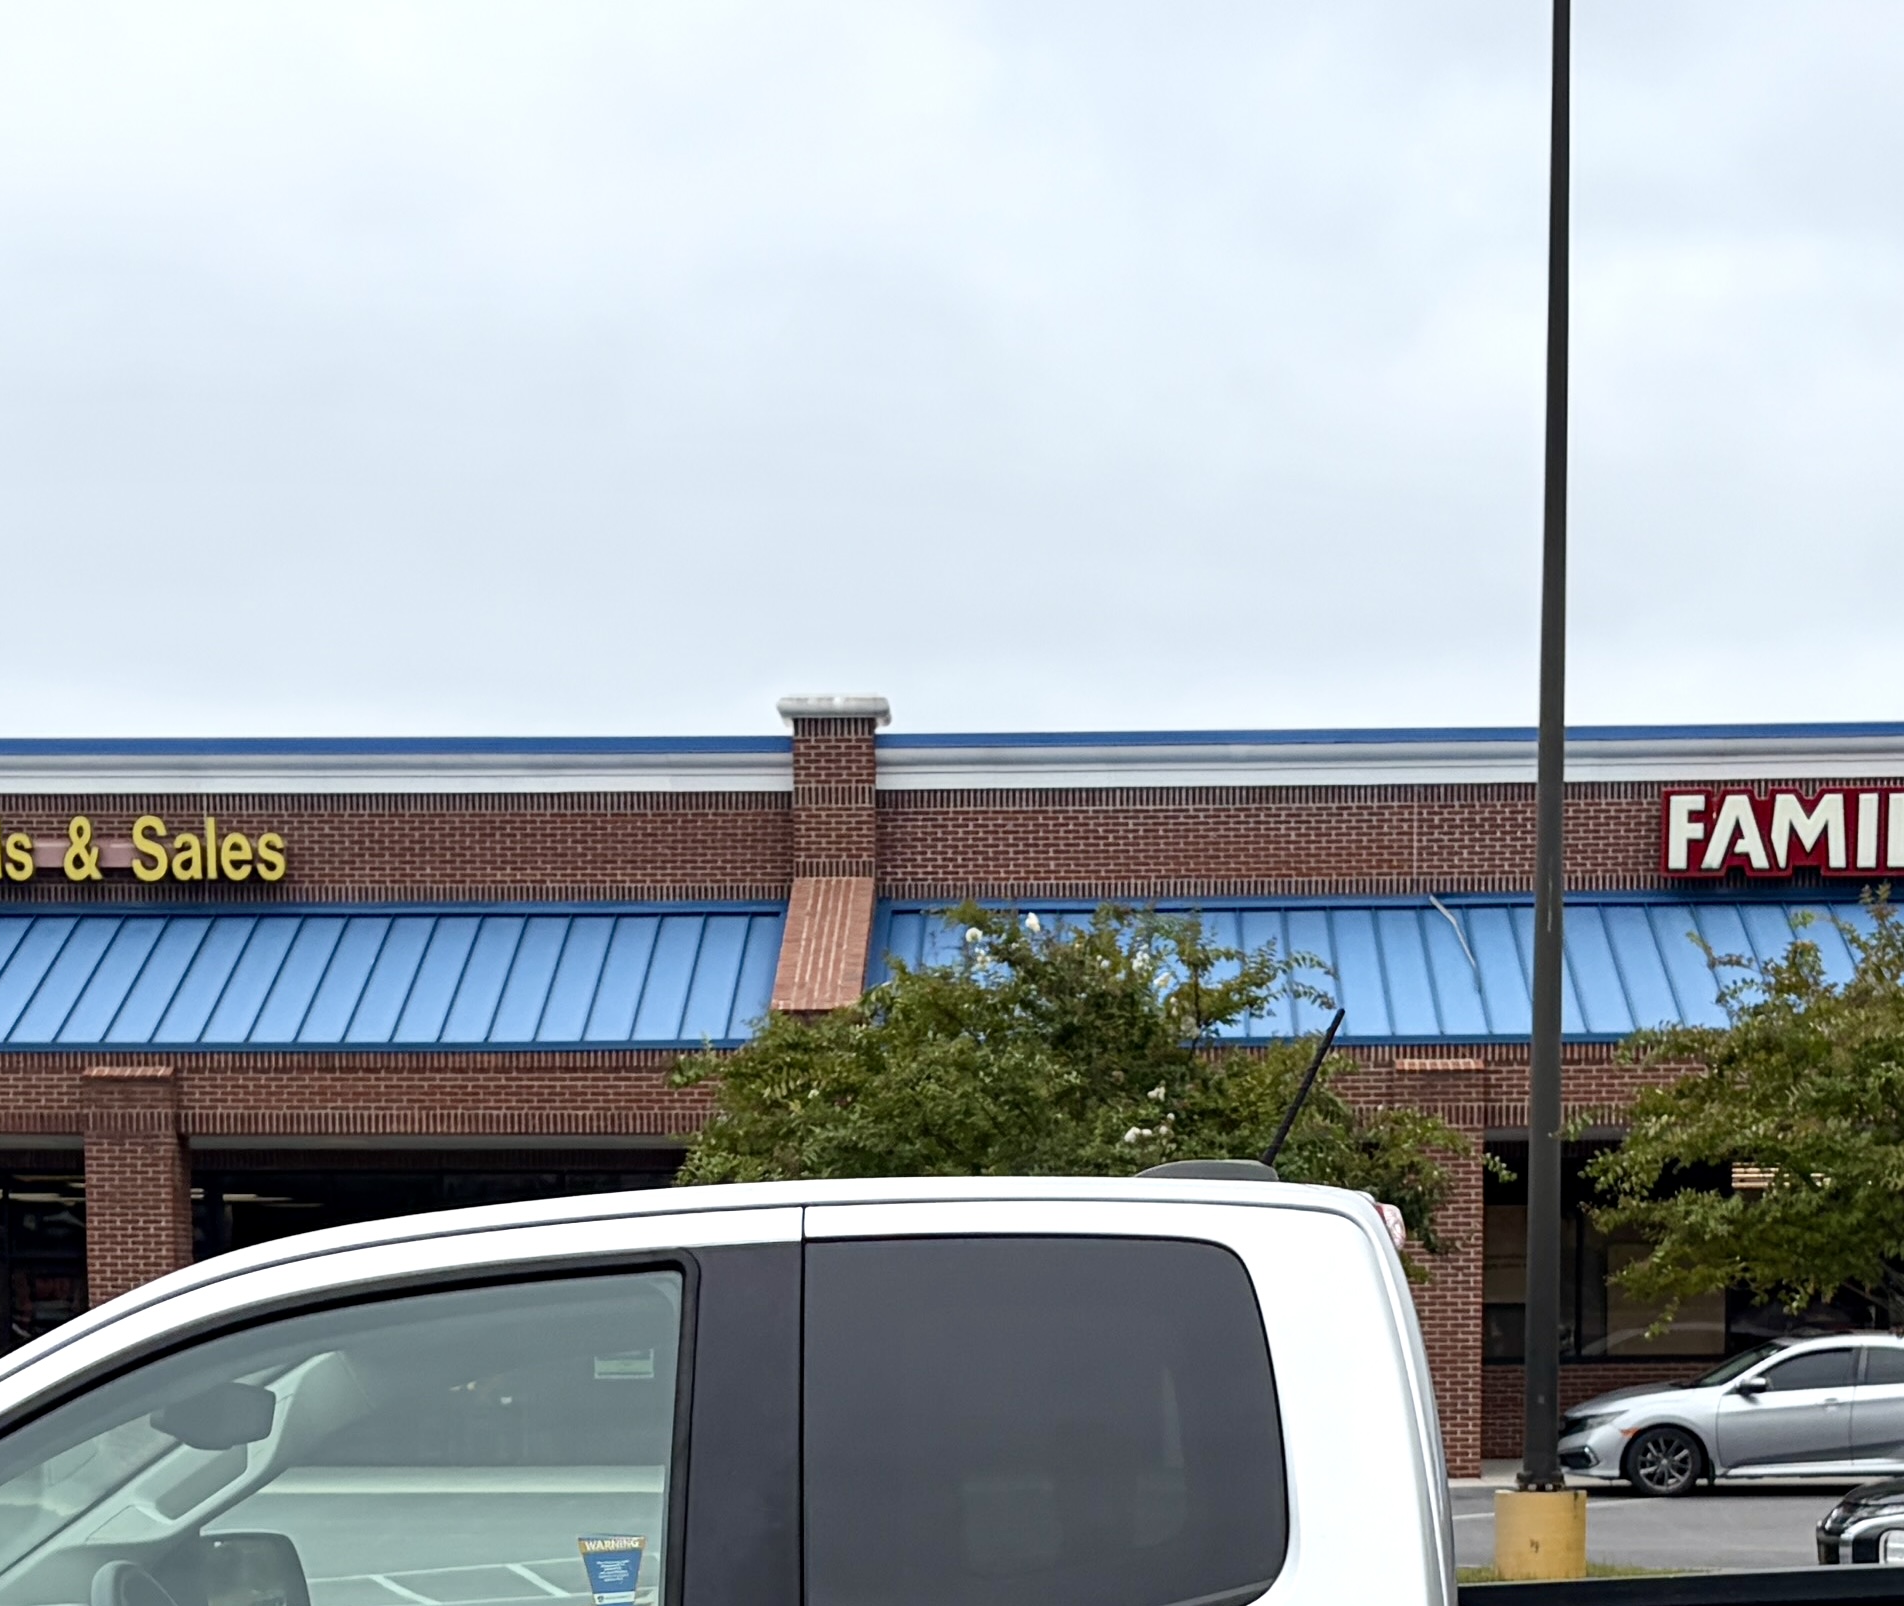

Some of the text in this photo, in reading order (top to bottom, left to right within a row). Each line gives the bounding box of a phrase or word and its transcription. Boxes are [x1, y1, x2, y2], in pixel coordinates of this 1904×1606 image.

[63, 816, 102, 880] &
[132, 815, 285, 881] Sales
[584, 1538, 640, 1551] WARNING
